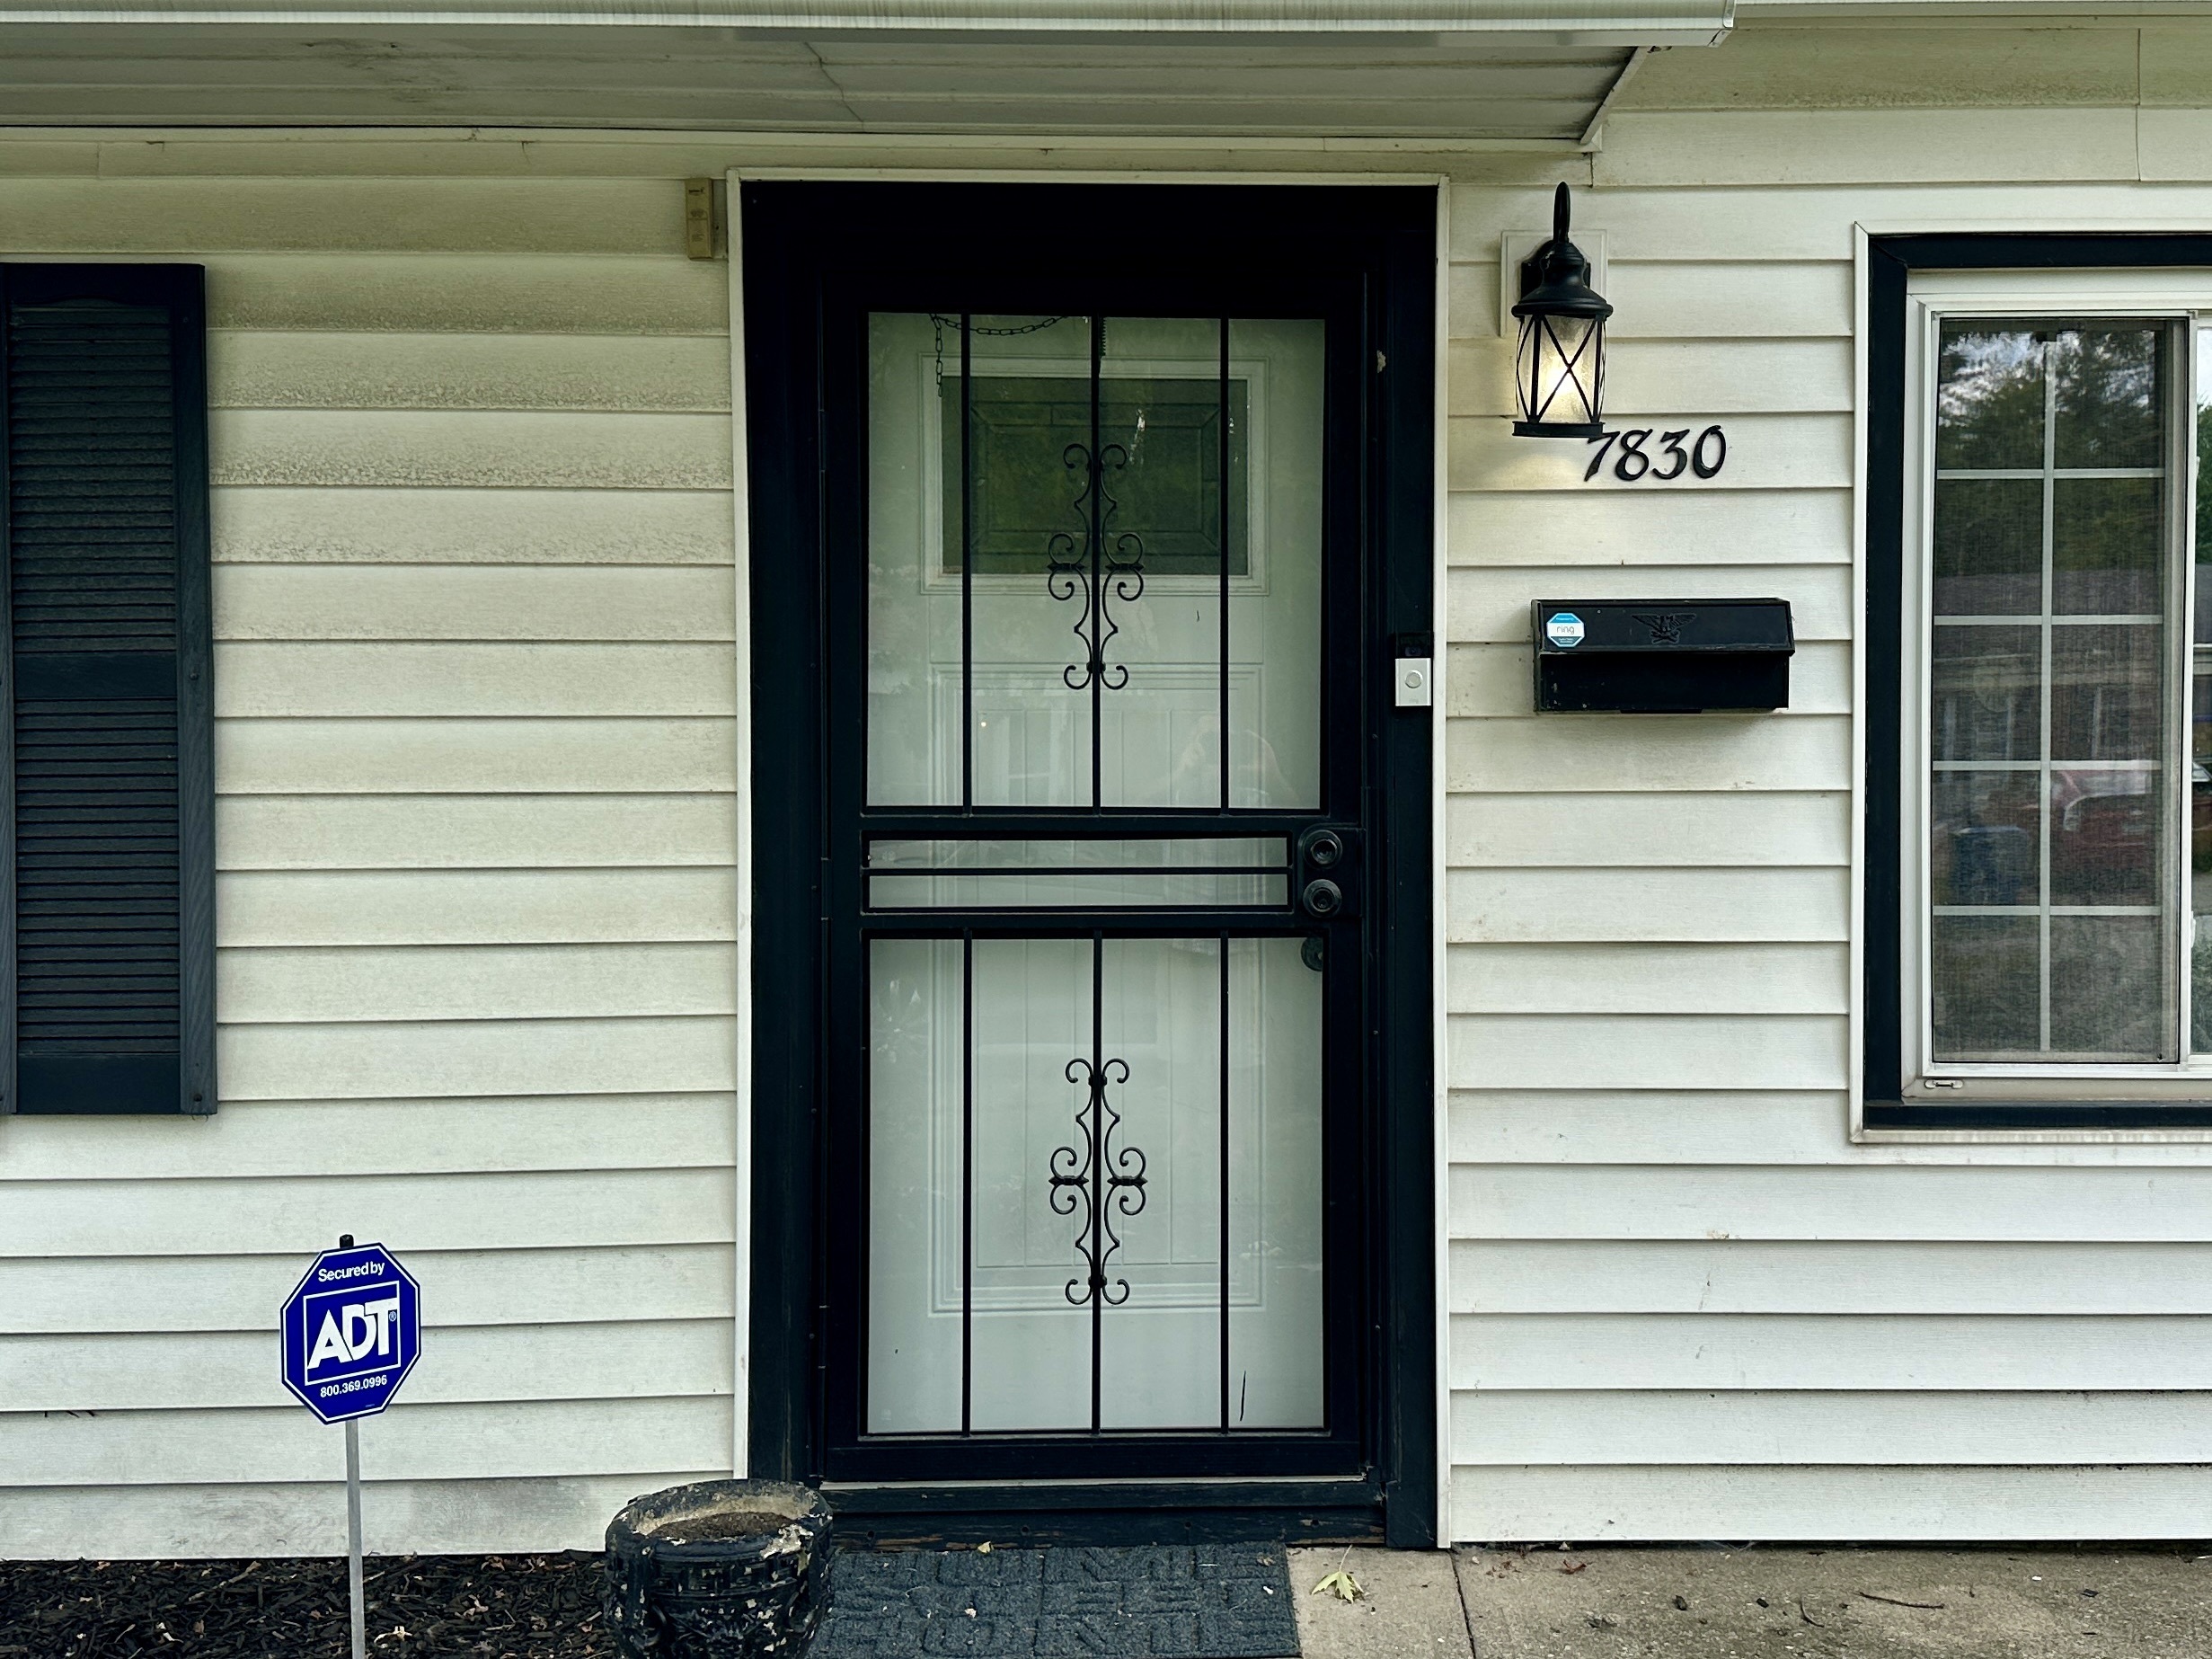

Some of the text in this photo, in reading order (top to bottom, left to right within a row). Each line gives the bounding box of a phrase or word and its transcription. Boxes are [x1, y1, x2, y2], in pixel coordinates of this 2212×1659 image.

[1584, 424, 1727, 483] 7830
[1556, 625, 1575, 635] ring
[318, 1261, 385, 1282] Secured by
[307, 1297, 398, 1370] ADT
[320, 1374, 387, 1397] 800.369.0996
